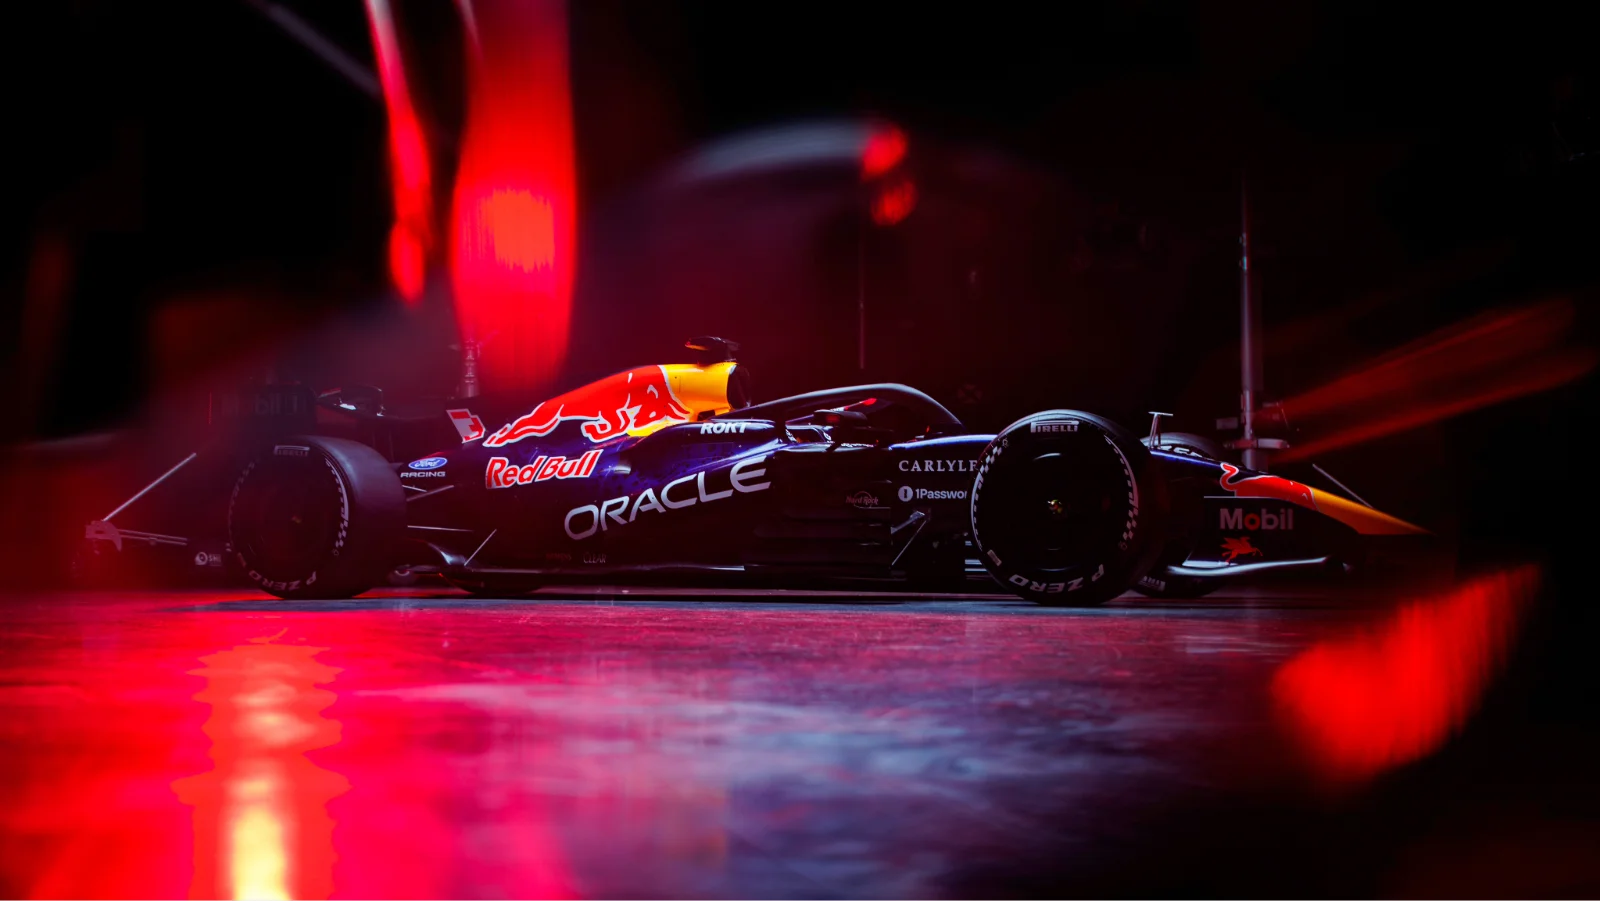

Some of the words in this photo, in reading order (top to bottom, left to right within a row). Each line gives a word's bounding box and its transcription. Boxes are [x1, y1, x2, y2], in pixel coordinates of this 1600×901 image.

[700, 422, 749, 435] ROKT
[1030, 420, 1080, 433] PIRELLI
[486, 457, 547, 489] Red
[534, 449, 604, 482] Bull
[564, 455, 771, 540] ORACLE
[1219, 507, 1294, 531] Mobil
[1091, 564, 1104, 582] P
[1008, 574, 1084, 593] ZERO
